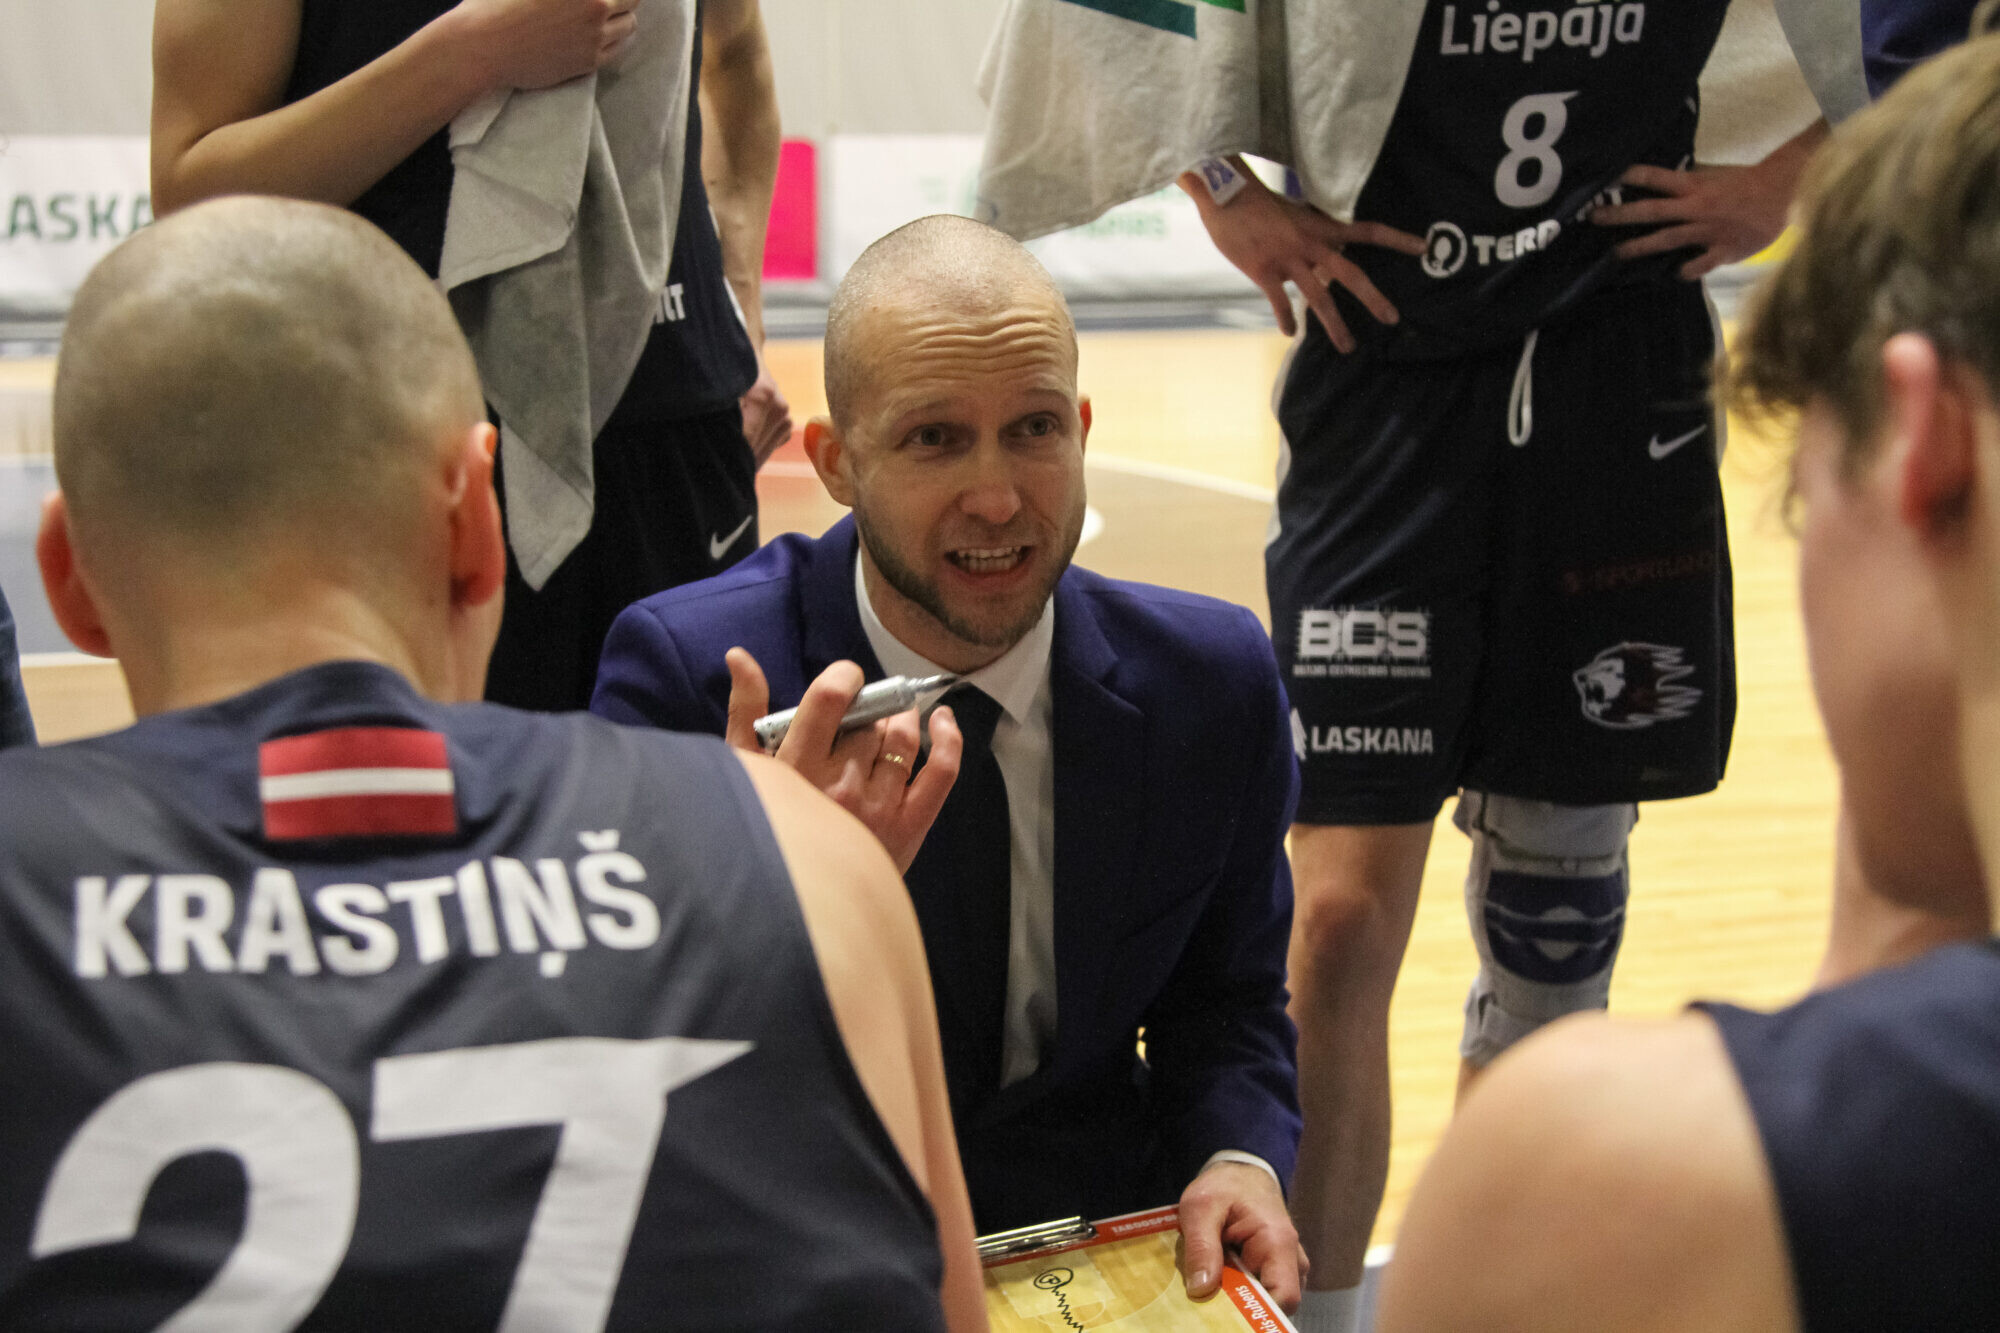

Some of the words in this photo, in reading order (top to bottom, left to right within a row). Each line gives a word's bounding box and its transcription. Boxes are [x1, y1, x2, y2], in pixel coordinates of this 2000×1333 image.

[1494, 90, 1580, 207] 8
[1298, 607, 1429, 657] BCS
[1310, 725, 1434, 754] LASKANA
[73, 830, 661, 979] KRASTIŅŠ
[30, 1036, 756, 1333] 27
